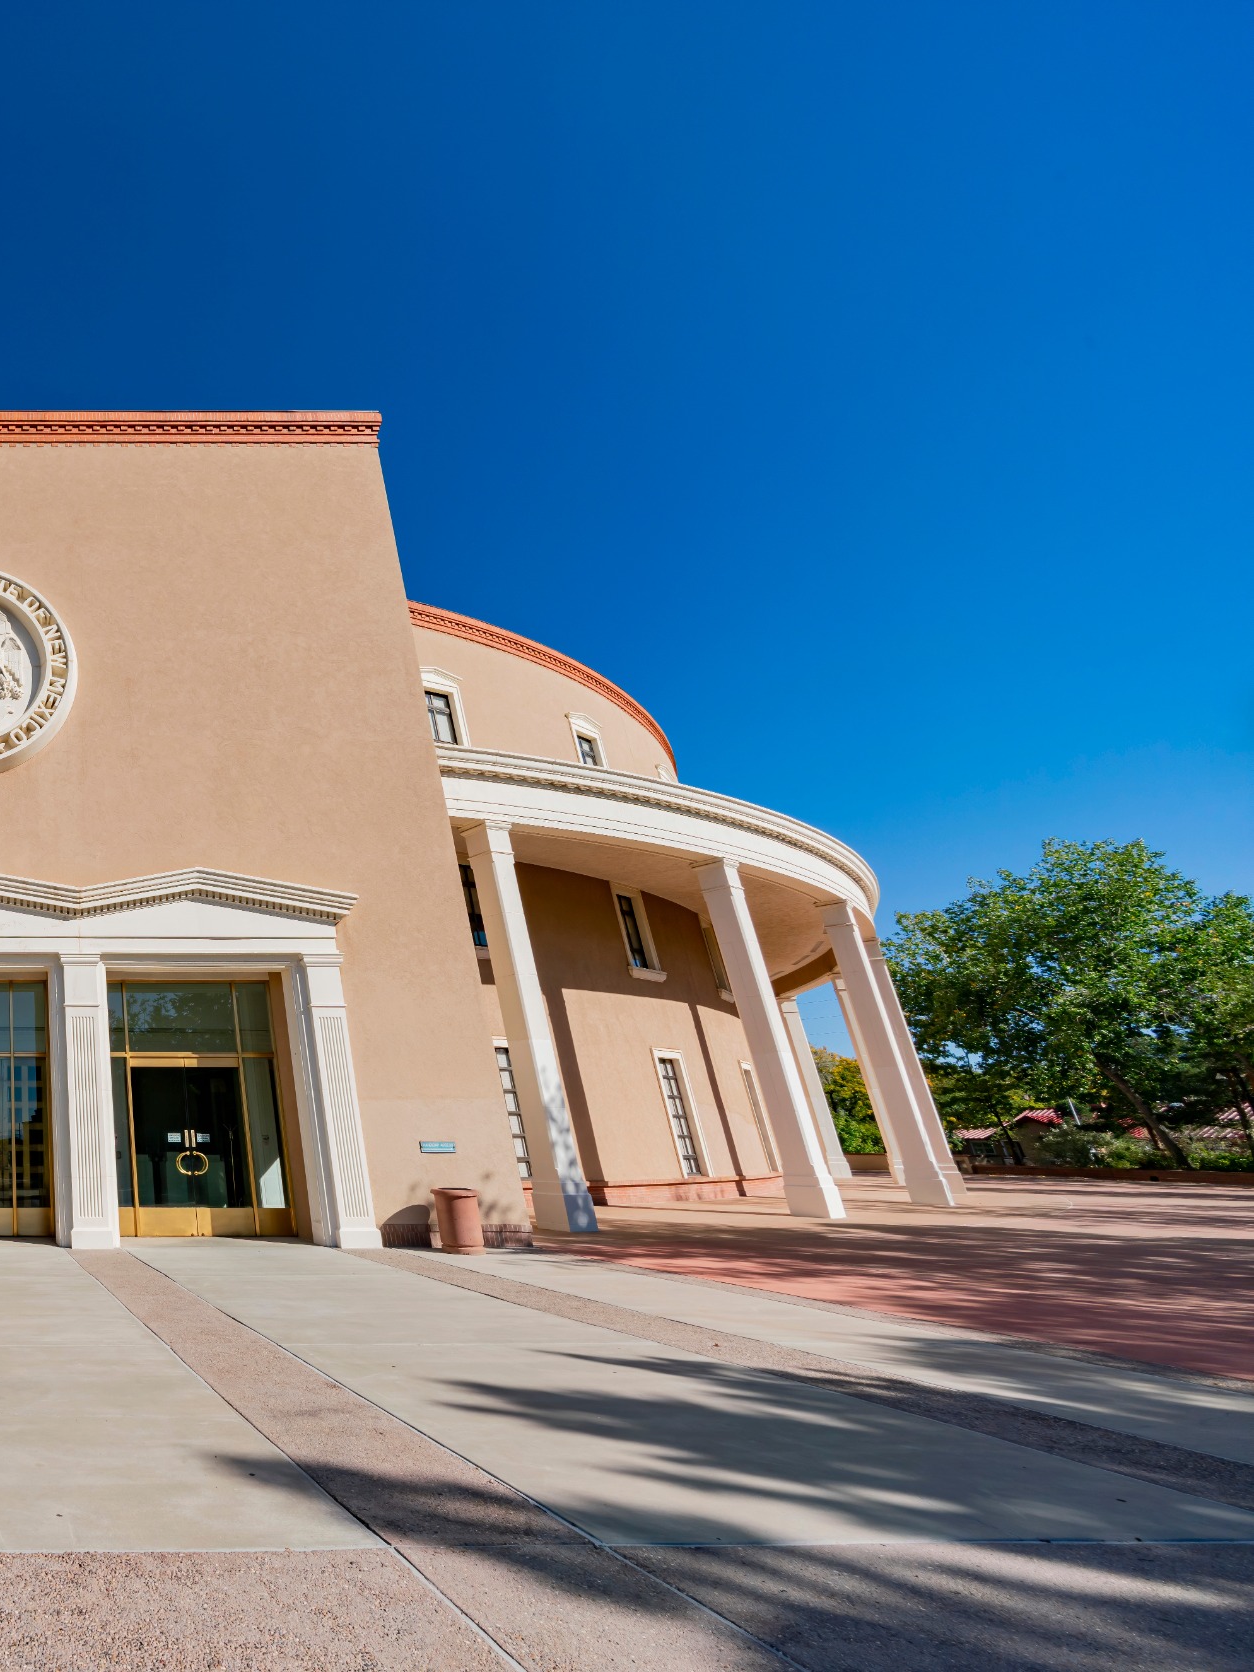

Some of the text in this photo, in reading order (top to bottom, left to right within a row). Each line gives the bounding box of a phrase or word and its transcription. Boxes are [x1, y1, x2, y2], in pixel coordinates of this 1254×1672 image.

[23, 596, 50, 622] OF
[43, 624, 67, 668] NEW
[10, 677, 66, 745] MEXICO
